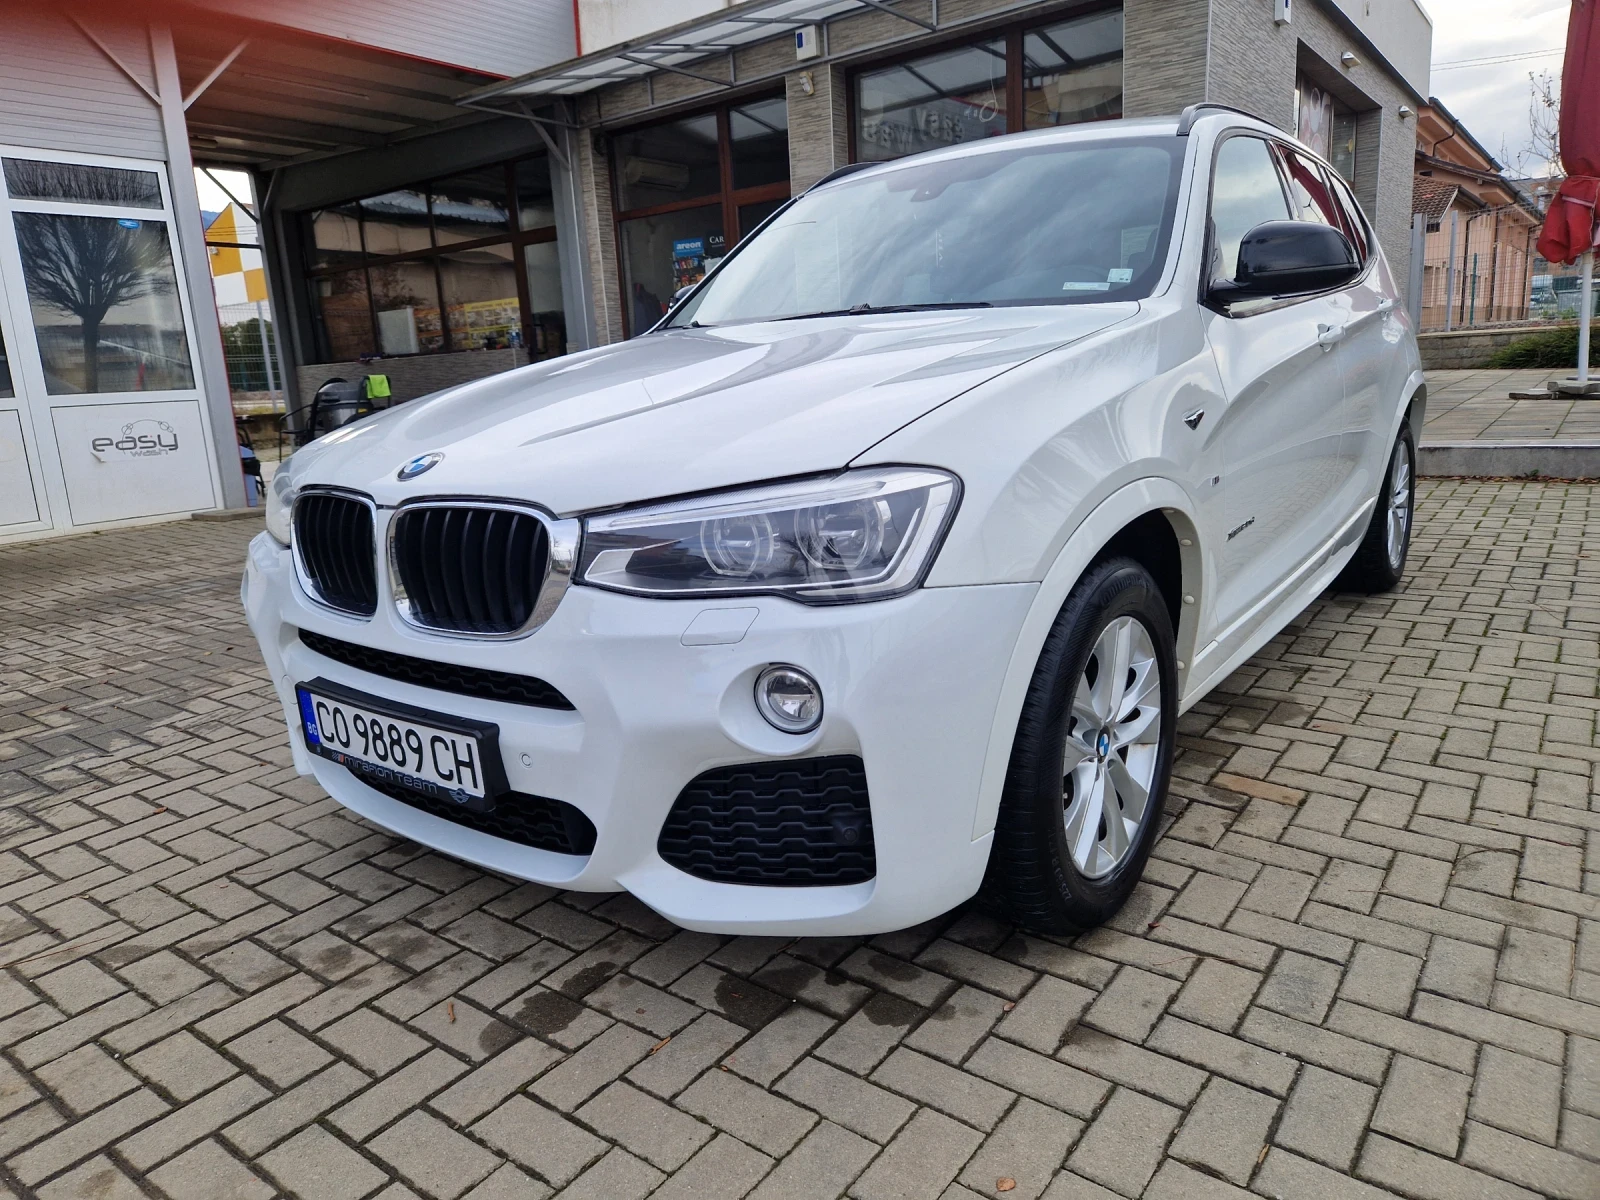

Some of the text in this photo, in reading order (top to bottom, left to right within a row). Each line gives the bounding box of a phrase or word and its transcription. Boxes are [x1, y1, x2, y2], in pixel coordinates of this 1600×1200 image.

[676, 241, 702, 250] areon
[709, 236, 724, 244] CAR
[92, 433, 179, 452] easy
[130, 449, 168, 457] wash
[307, 721, 318, 736] BG
[353, 713, 423, 773] 9889
